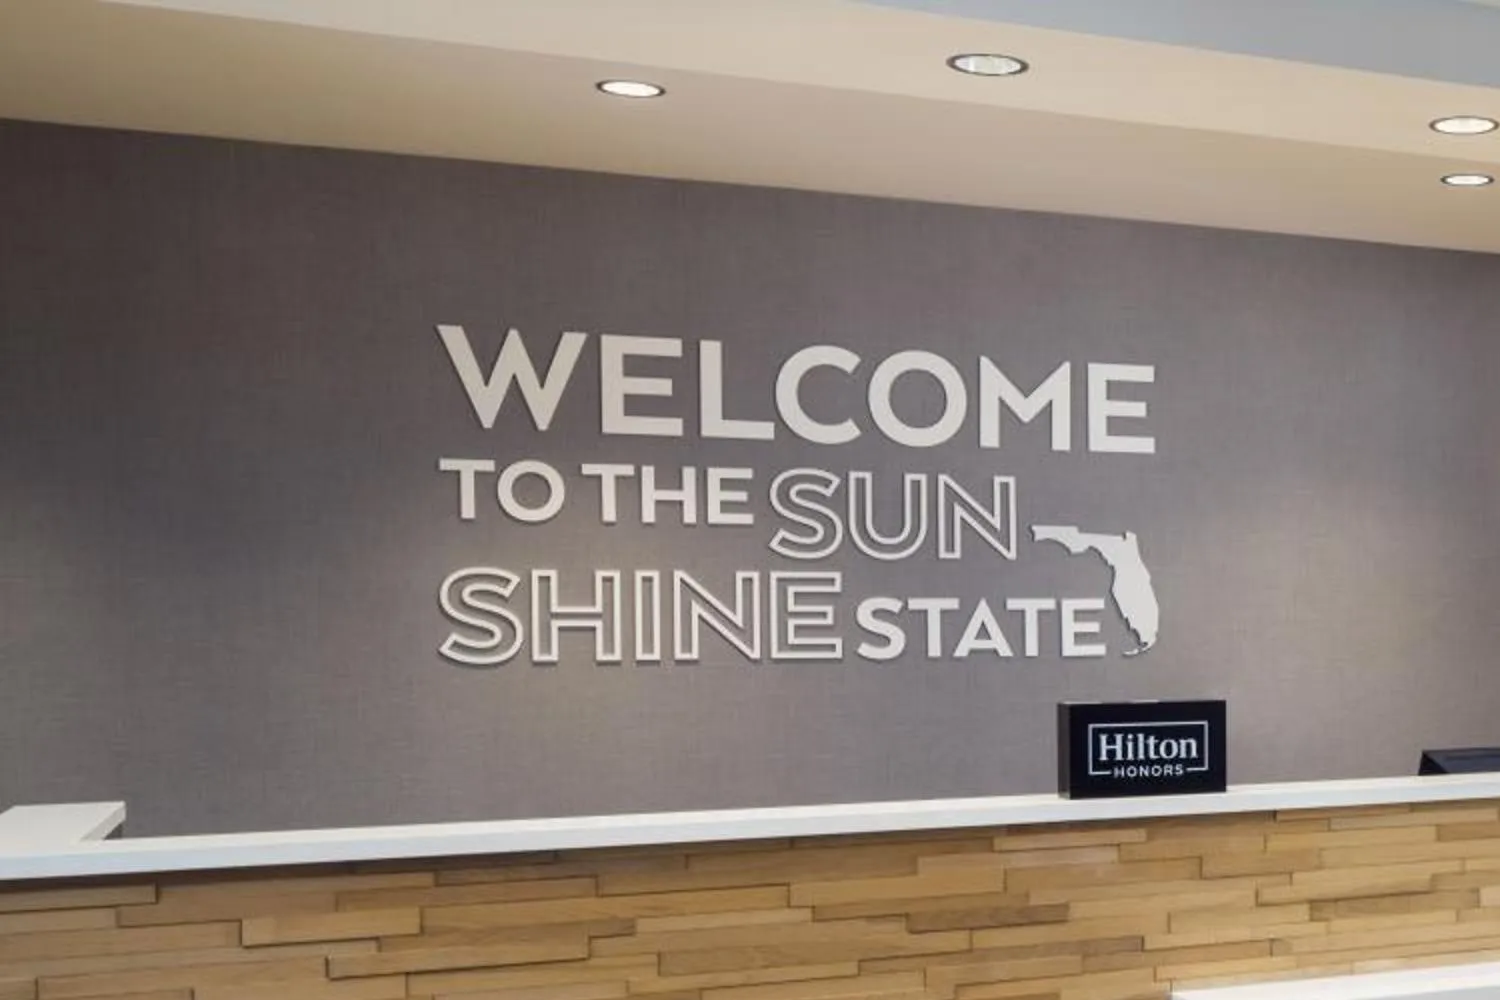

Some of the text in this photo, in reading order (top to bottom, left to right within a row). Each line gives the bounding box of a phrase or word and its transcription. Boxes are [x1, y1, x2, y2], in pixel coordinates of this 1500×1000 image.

[438, 325, 1156, 454] WELCOME
[439, 458, 1017, 561] TO THE SUN
[438, 566, 1107, 665] SHINE STATE
[1098, 733, 1199, 761] Hilton
[1113, 764, 1184, 778] HONORS
